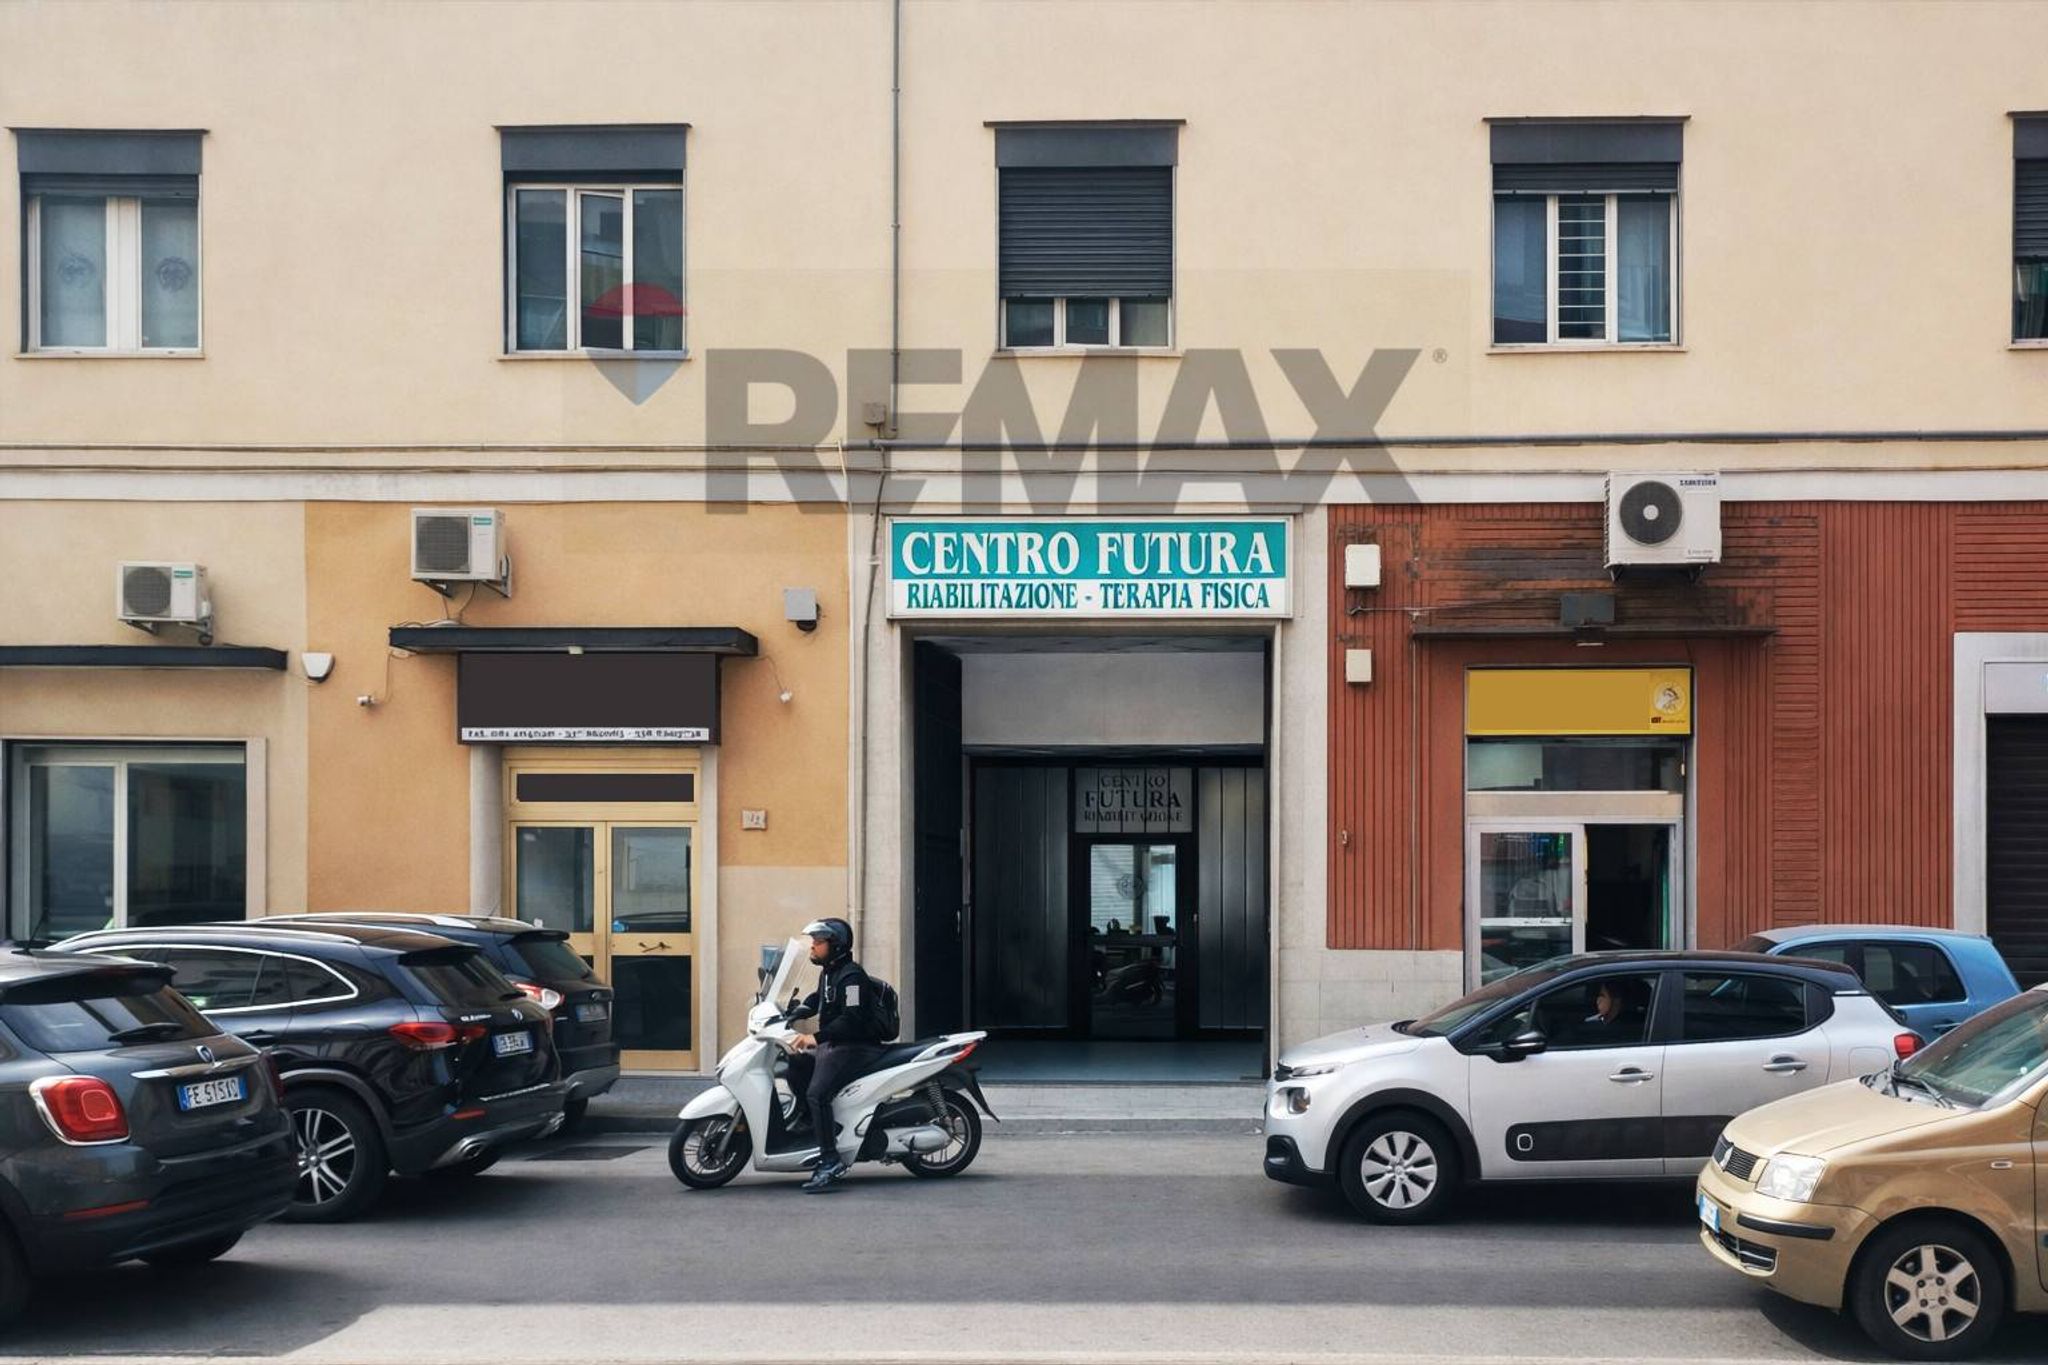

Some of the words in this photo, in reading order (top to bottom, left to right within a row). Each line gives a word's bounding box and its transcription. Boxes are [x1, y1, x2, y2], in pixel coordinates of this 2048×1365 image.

[902, 531, 1080, 575] CENTRO
[1096, 531, 1274, 575] FUTURA
[906, 583, 1078, 609] RIABILITAZIONE
[1100, 583, 1193, 609] TERAPIA
[1200, 583, 1270, 609] FISICA
[1101, 775, 1166, 788] CENTRO
[1085, 790, 1181, 808] FUTURA
